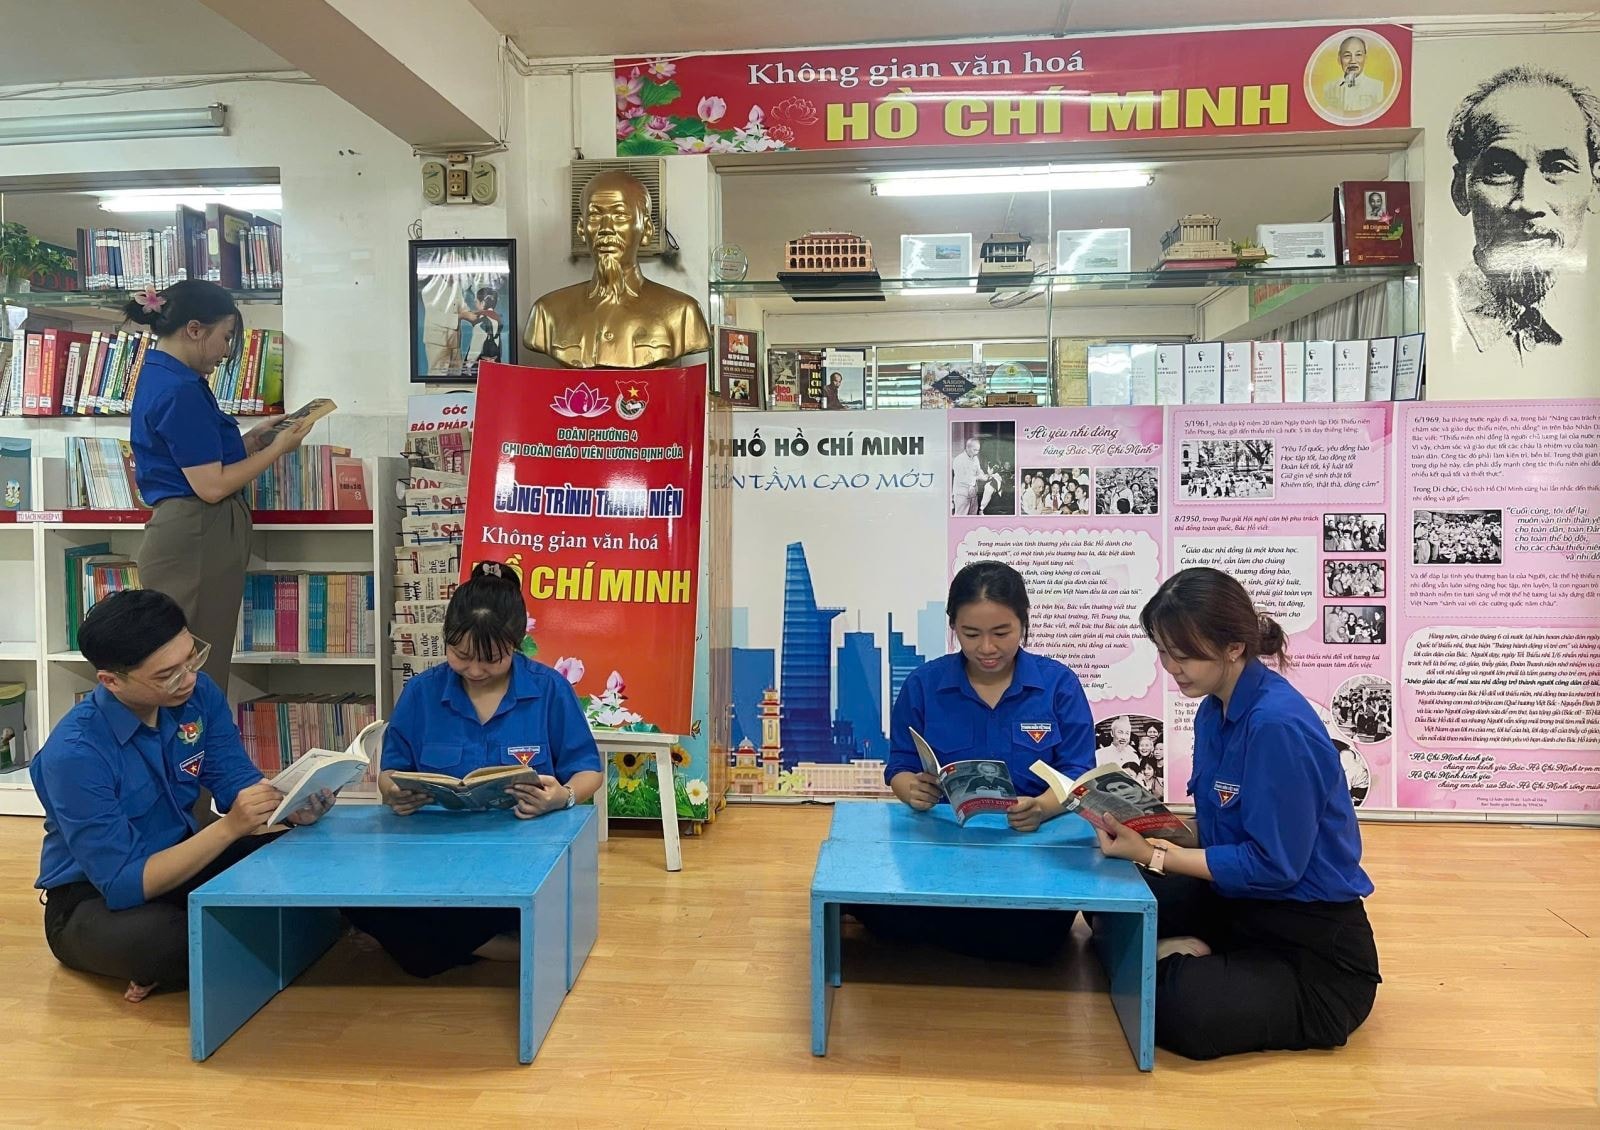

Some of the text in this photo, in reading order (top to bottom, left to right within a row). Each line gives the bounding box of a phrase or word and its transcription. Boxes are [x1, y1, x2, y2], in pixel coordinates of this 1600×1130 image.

[748, 50, 1084, 87] Không gian văn hoá
[945, 86, 1065, 136] CHÍ
[1090, 84, 1288, 132] MINH
[442, 405, 467, 414] GÓC
[411, 419, 468, 431] BÁO PHÁP
[558, 428, 637, 441] ĐOÀN PHƯỜNG 4
[1047, 428, 1069, 442] yêu
[1070, 425, 1089, 437] nhi
[1091, 426, 1119, 440] đồng
[503, 443, 683, 462] CHI ĐOÀN GIÁO VIÊN LƯƠNG ĐỊNH CỦA
[775, 428, 809, 456] HỒ
[817, 432, 854, 456] CHÍ
[862, 436, 924, 455] MINH
[1066, 445, 1087, 455] Bác
[1088, 444, 1105, 455] Hồ
[1107, 444, 1123, 456] Chí
[749, 466, 806, 490] TẦM
[813, 474, 869, 489] CAO
[545, 483, 593, 517] TRÌNH
[648, 484, 683, 518] NIÊN
[481, 526, 658, 552] Không gian văn hoá
[531, 561, 596, 600] CHÍ
[599, 568, 690, 603] MINH
